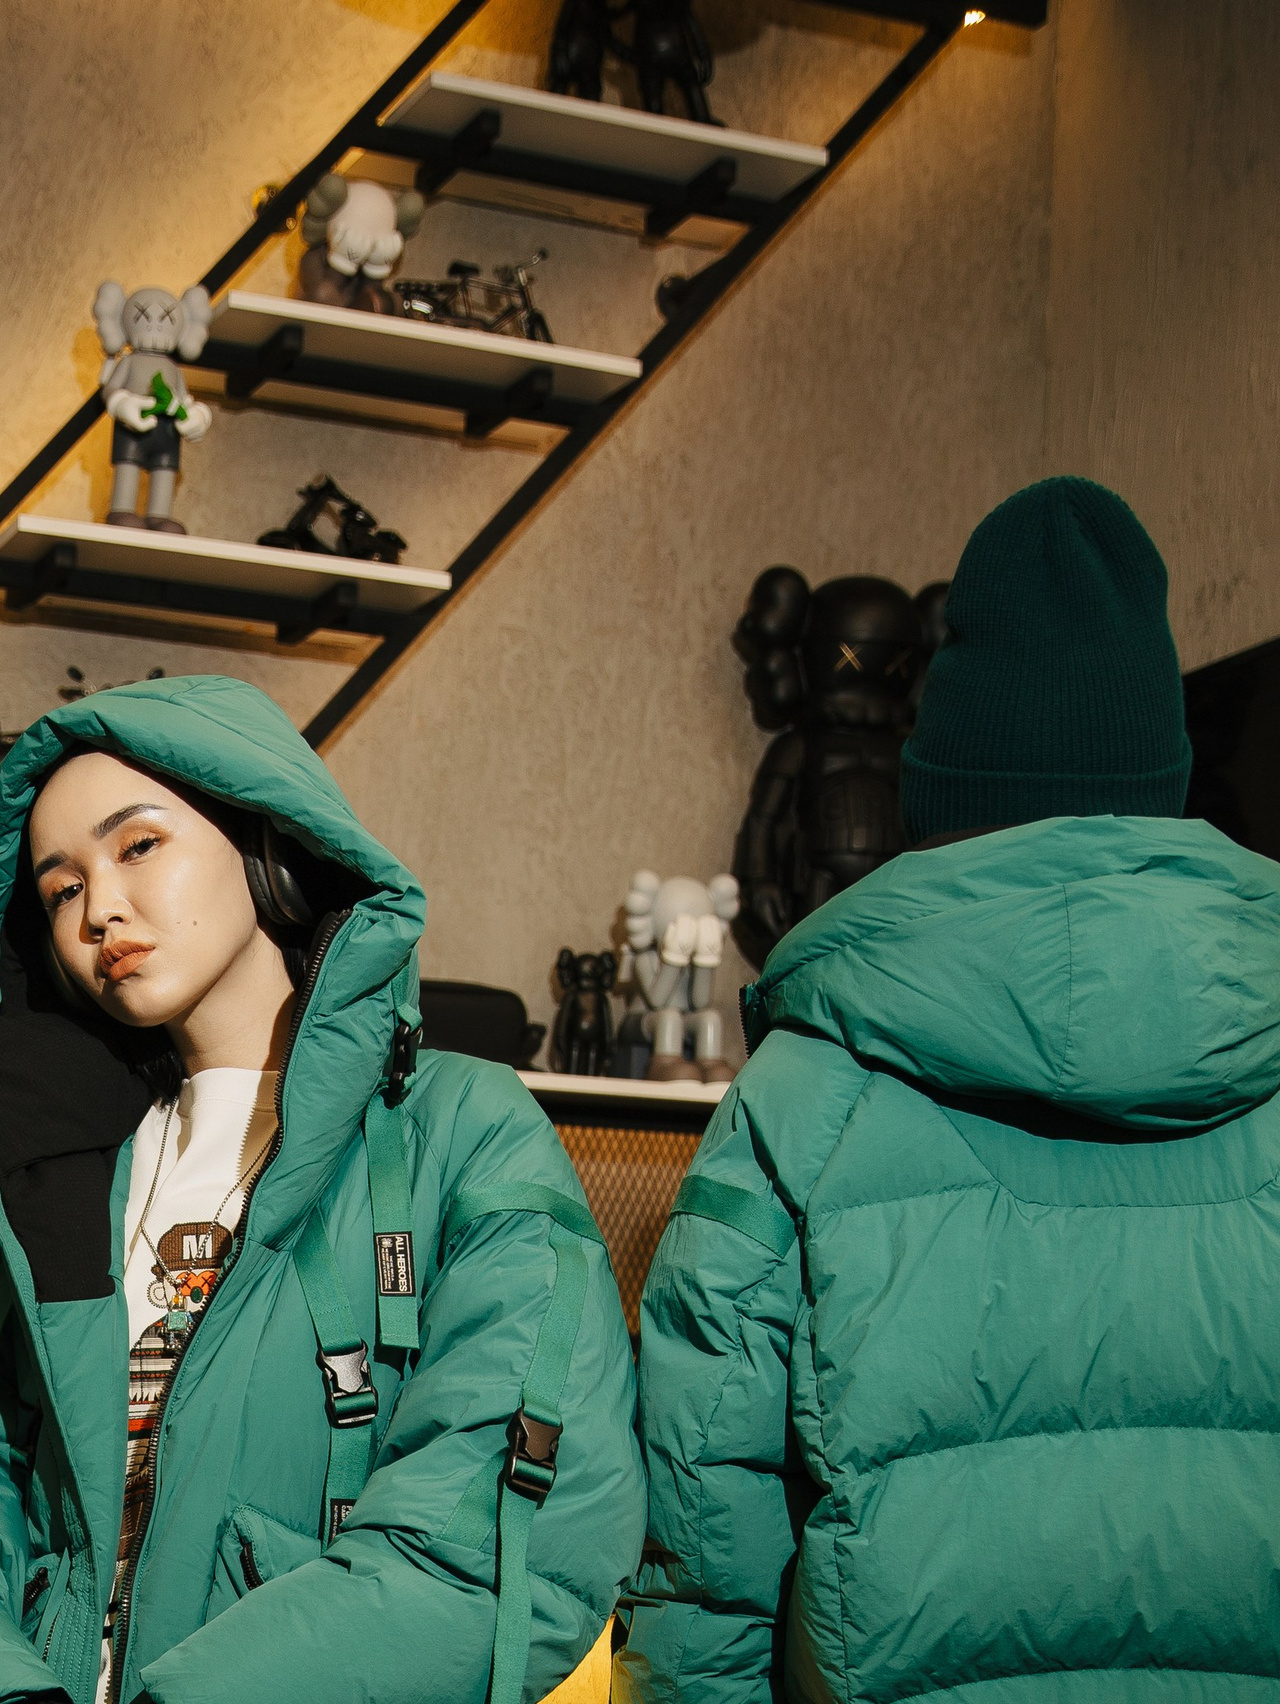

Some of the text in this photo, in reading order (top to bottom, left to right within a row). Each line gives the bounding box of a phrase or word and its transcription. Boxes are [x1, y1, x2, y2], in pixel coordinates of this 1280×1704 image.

[183, 1235, 213, 1260] M
[395, 1236, 408, 1292] ALL HEROES
